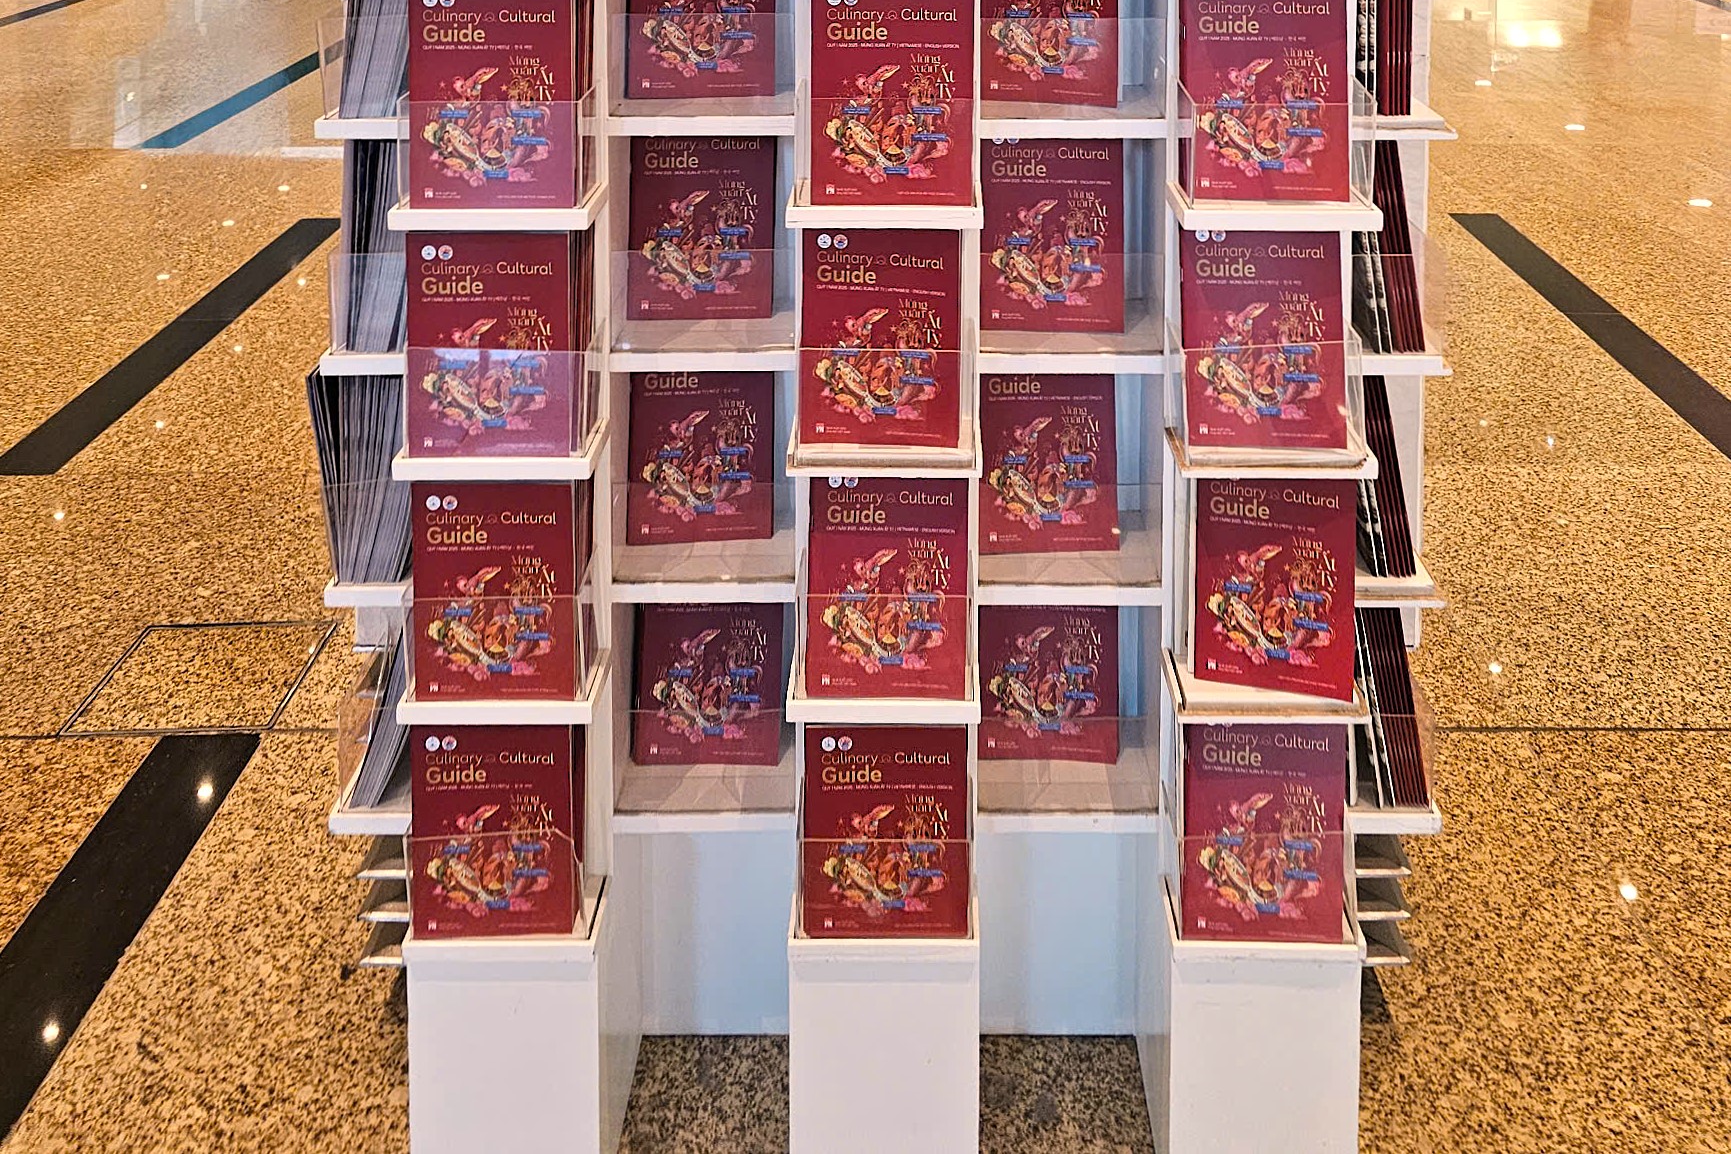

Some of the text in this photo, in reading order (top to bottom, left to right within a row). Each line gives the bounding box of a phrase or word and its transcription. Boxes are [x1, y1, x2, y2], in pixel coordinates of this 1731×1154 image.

[423, 10, 555, 25] Culinary Cultural
[827, 8, 957, 25] Culinary Cultural
[1198, 2, 1330, 17] Culinary Cultural
[827, 22, 887, 40] Guide
[1199, 15, 1259, 33] Guide
[423, 24, 485, 42] Guide
[645, 138, 760, 152] Culinary Cultural
[991, 146, 1109, 161] Culinary Cultural
[645, 152, 699, 168] Guide
[992, 159, 1046, 176] Guide
[817, 251, 943, 269] Culinary Cultural
[1195, 244, 1324, 260] Culinary Cultural
[421, 262, 552, 278] Culinary Cultural
[817, 265, 876, 283] Guide
[1196, 259, 1256, 277] Guide
[422, 276, 483, 295] Guide
[644, 372, 698, 389] Guide
[989, 377, 1041, 394] Guide
[828, 490, 953, 506] Culinary Cultural
[1210, 481, 1340, 510] Culinary Cultural
[827, 504, 886, 524] Guide
[1210, 497, 1269, 519] Guide
[426, 512, 556, 528] Culinary Cultural
[427, 526, 488, 544] Guide
[1203, 729, 1329, 752] Culinary Cultural
[425, 752, 554, 767] Culinary Cultural
[821, 752, 950, 767] Culinary Cultural
[1203, 744, 1261, 767] Guide
[426, 765, 486, 783] Guide
[822, 765, 882, 783] Guide
